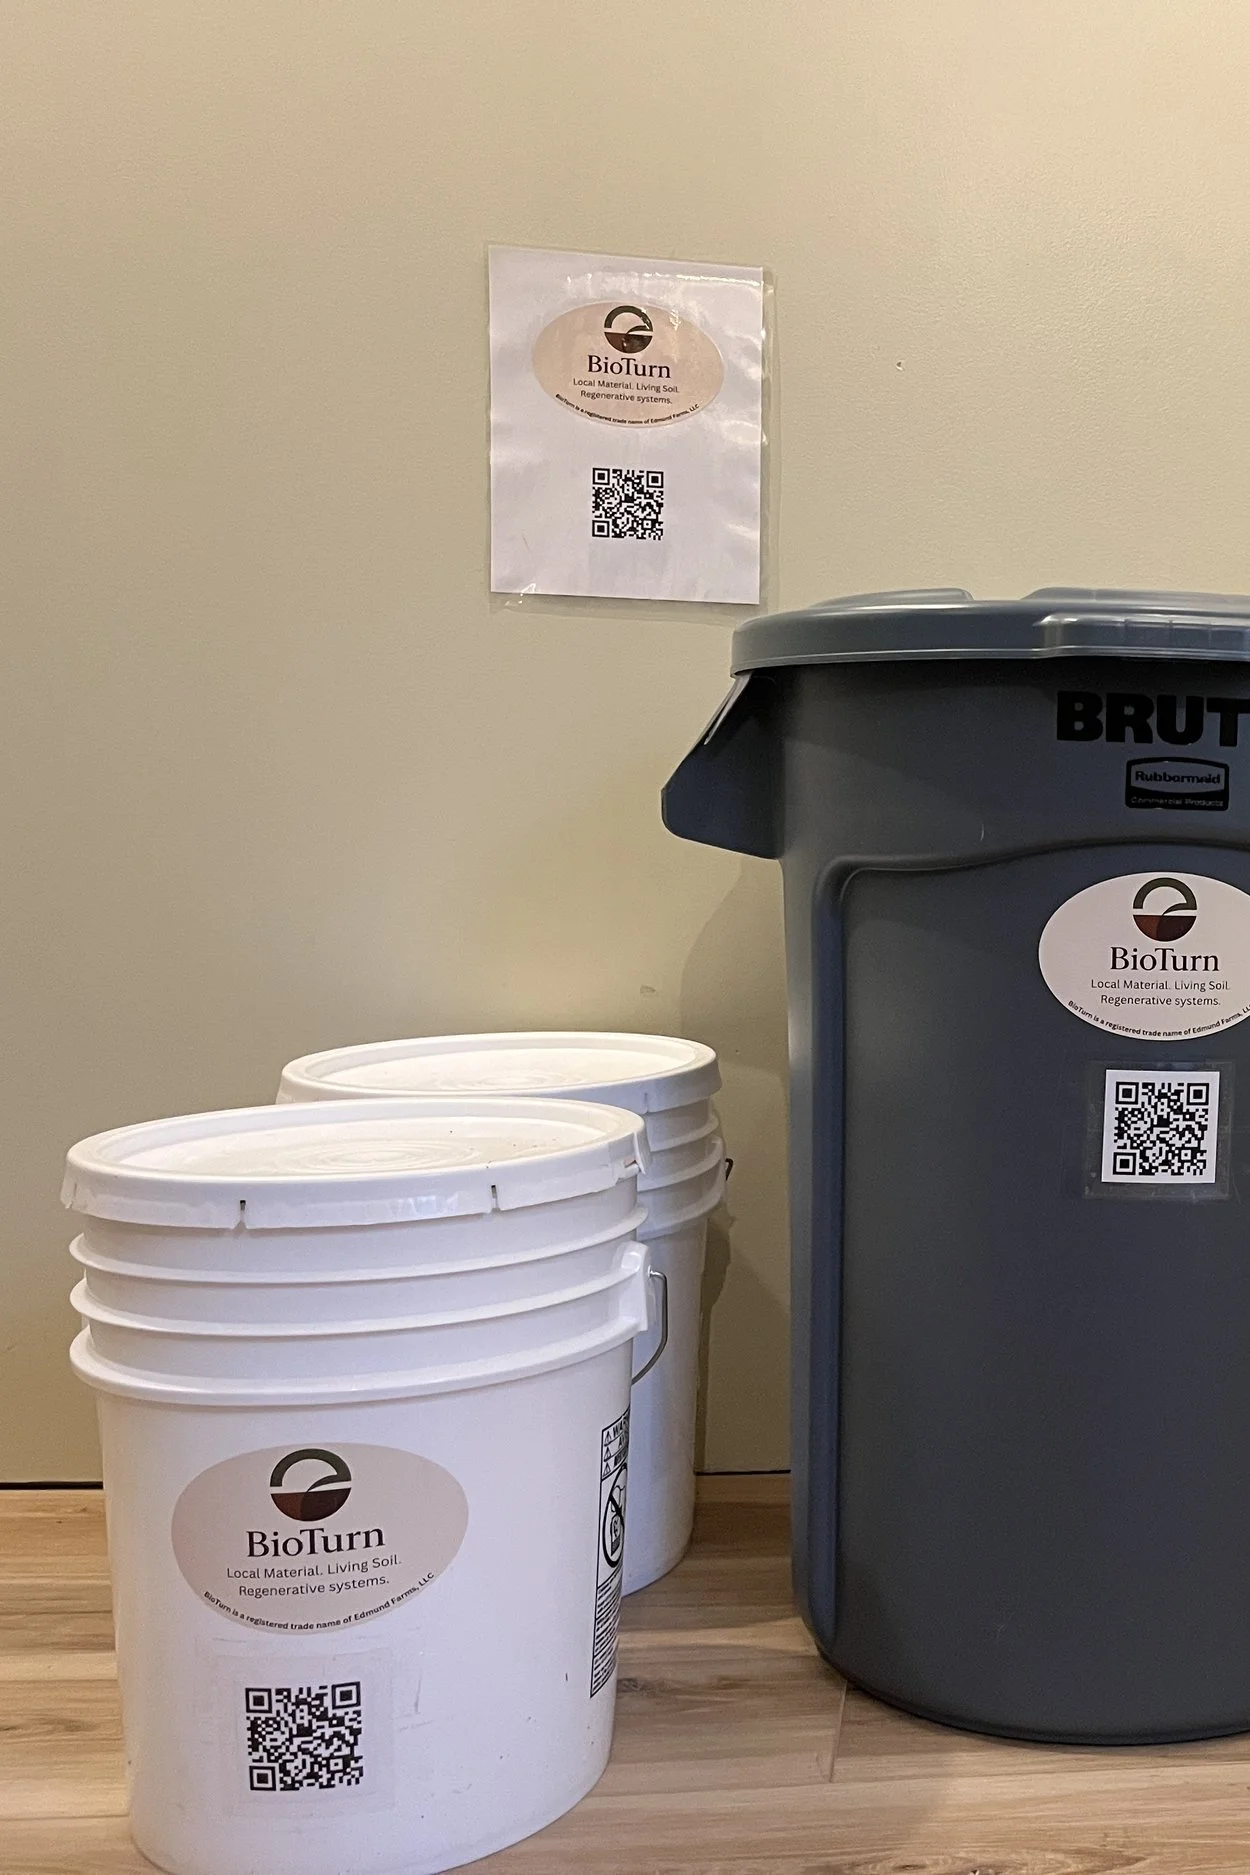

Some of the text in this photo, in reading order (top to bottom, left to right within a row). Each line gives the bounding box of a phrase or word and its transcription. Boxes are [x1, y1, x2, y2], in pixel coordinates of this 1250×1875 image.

[588, 354, 671, 378] BioTurn
[573, 378, 595, 386] Local
[598, 380, 634, 390] Material.
[636, 382, 660, 393] Living
[580, 390, 672, 404] Regenerative systems.
[1135, 770, 1220, 784] Rubbermaid
[1110, 947, 1219, 972] BioTurn
[1091, 979, 1230, 992] Local Material. Living Soil.
[1101, 994, 1220, 1008] Regenerative systems.
[1068, 1000, 1092, 1019] BioTurn
[1106, 1021, 1141, 1035] registered
[1193, 1021, 1220, 1033] Edmund
[246, 1527, 386, 1558] BioTurn
[227, 1554, 401, 1578] Local Material. Living Soil.
[239, 1576, 389, 1599] Regenerative systems.
[204, 1591, 231, 1612] BioTurn
[246, 1615, 288, 1629] registered
[316, 1620, 341, 1628] name
[354, 1601, 390, 1620] Edmund
[391, 1586, 420, 1604] Farms,
[419, 1572, 434, 1586] LLC
